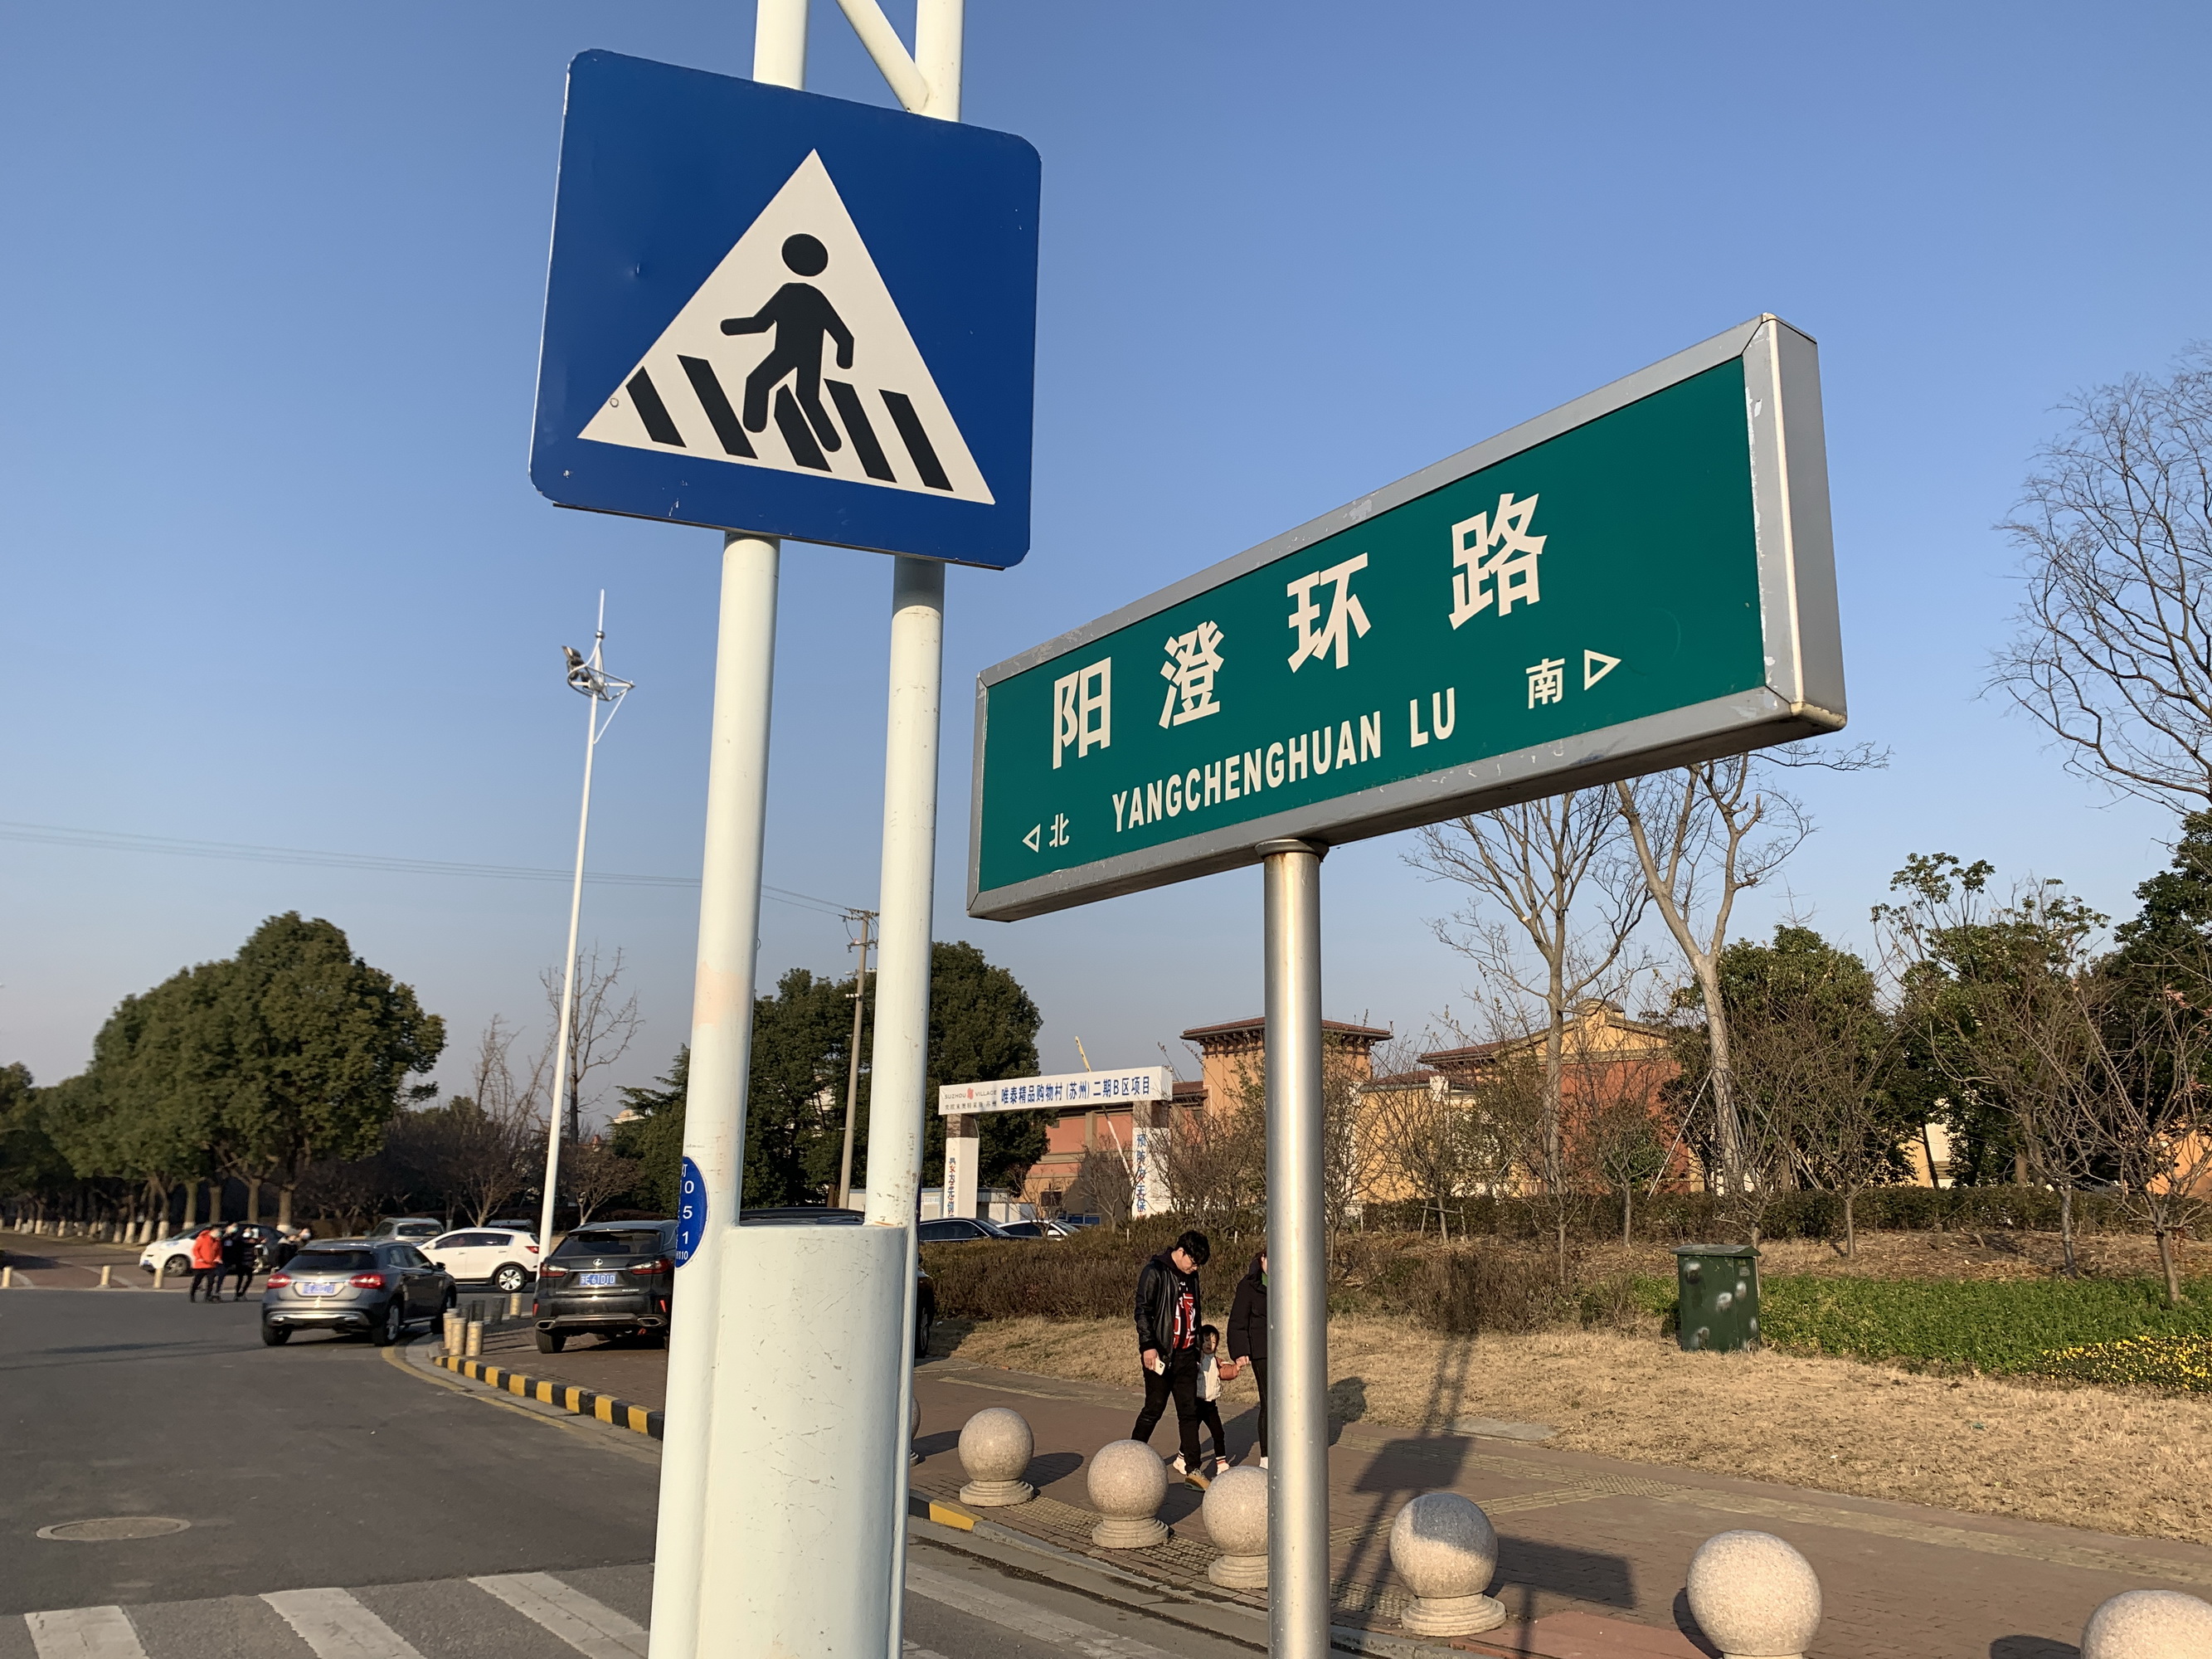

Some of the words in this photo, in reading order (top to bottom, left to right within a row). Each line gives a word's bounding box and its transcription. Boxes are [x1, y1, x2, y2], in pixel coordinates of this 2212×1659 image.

[1053, 493, 1548, 770] 阳澄环路
[1525, 657, 1566, 710] 南
[1112, 710, 1382, 833] YANGCHENGHUAN
[1409, 686, 1456, 749] LU
[1048, 812, 1070, 849] 北
